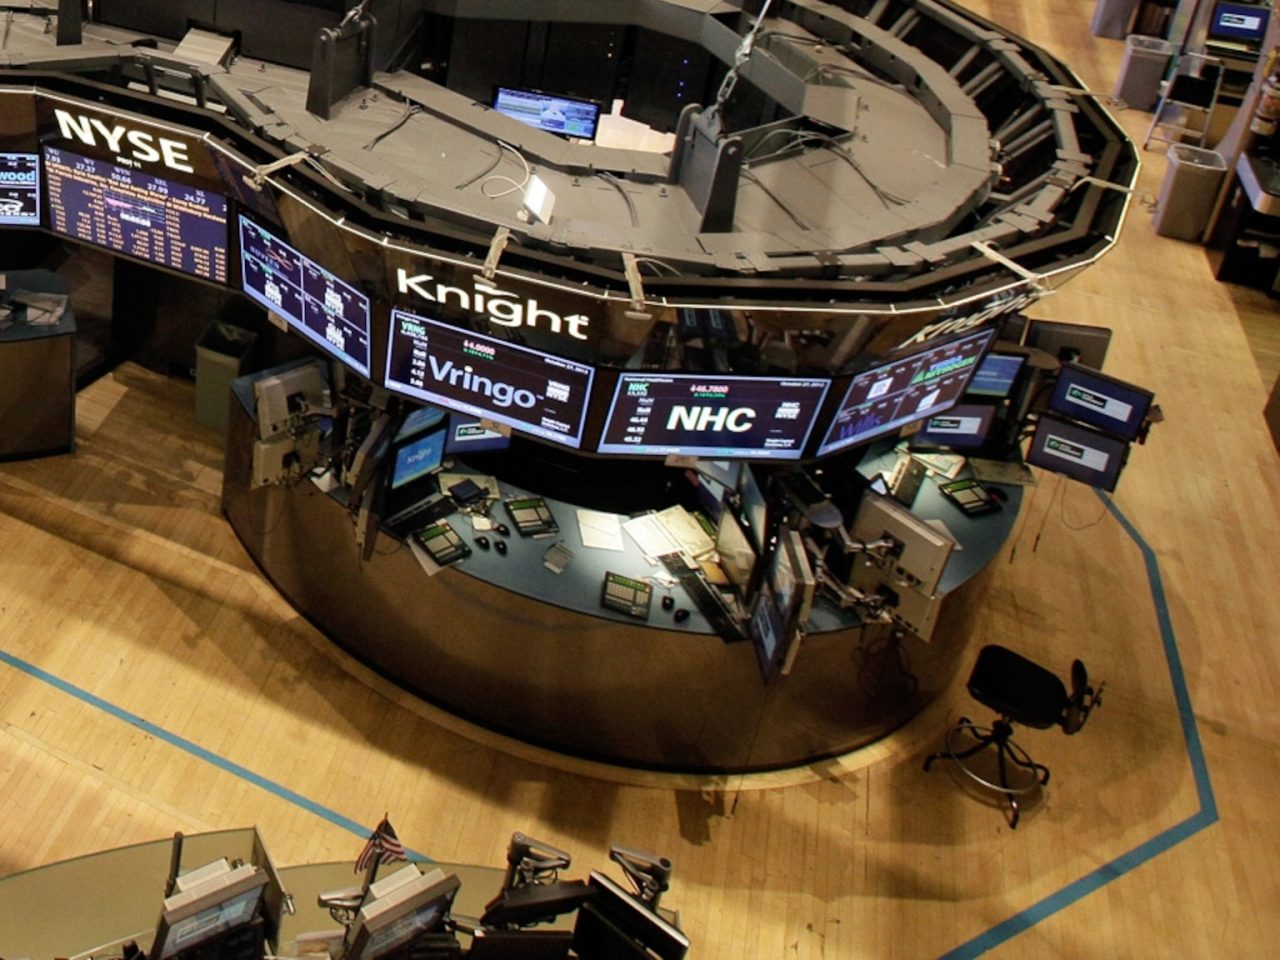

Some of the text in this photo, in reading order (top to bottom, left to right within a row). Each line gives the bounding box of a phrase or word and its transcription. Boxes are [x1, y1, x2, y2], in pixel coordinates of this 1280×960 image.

[54, 108, 194, 174] NYSE
[397, 268, 590, 340] Knight
[402, 321, 426, 335] VRNG
[428, 354, 537, 409] Vringo
[627, 383, 649, 392] NHC
[666, 404, 756, 433] NHC
